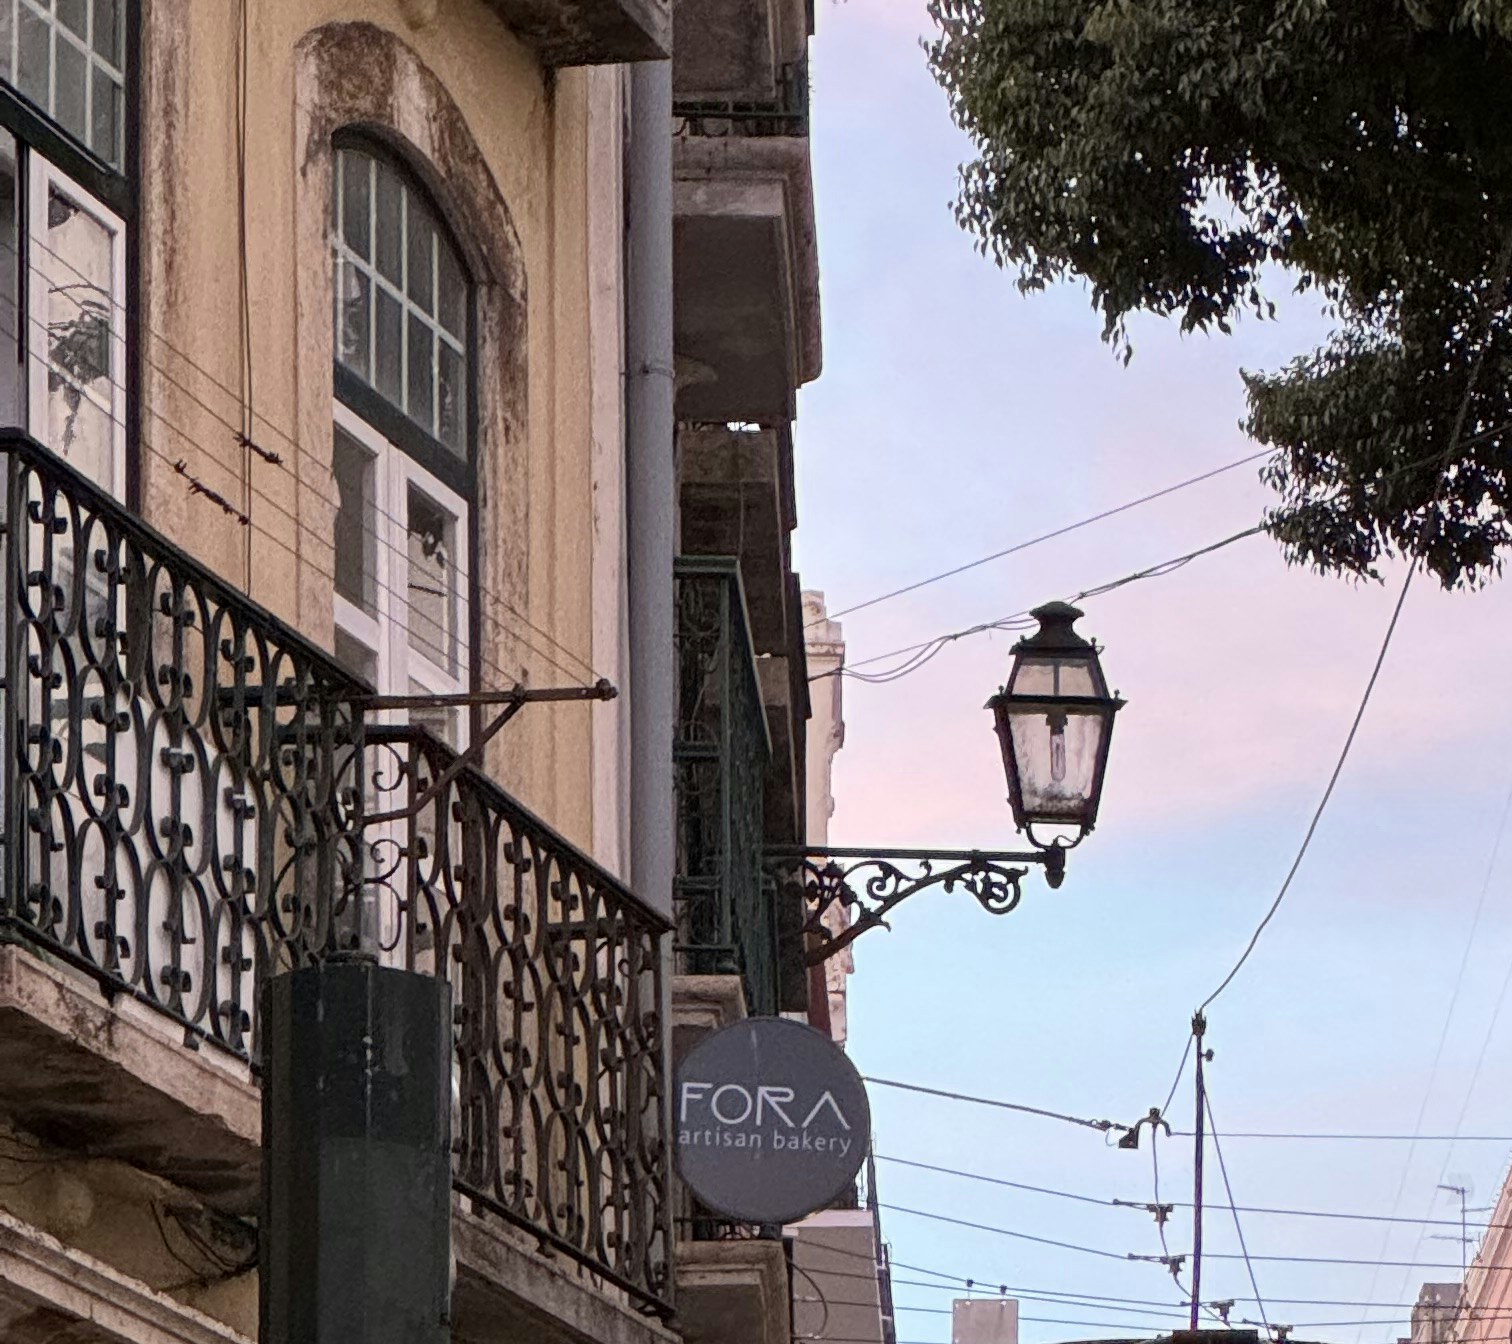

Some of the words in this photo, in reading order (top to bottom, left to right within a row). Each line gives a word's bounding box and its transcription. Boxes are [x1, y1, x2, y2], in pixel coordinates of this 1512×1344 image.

[680, 1081, 851, 1130] FORA
[678, 1125, 761, 1147] artisan
[773, 1129, 852, 1158] bakery
